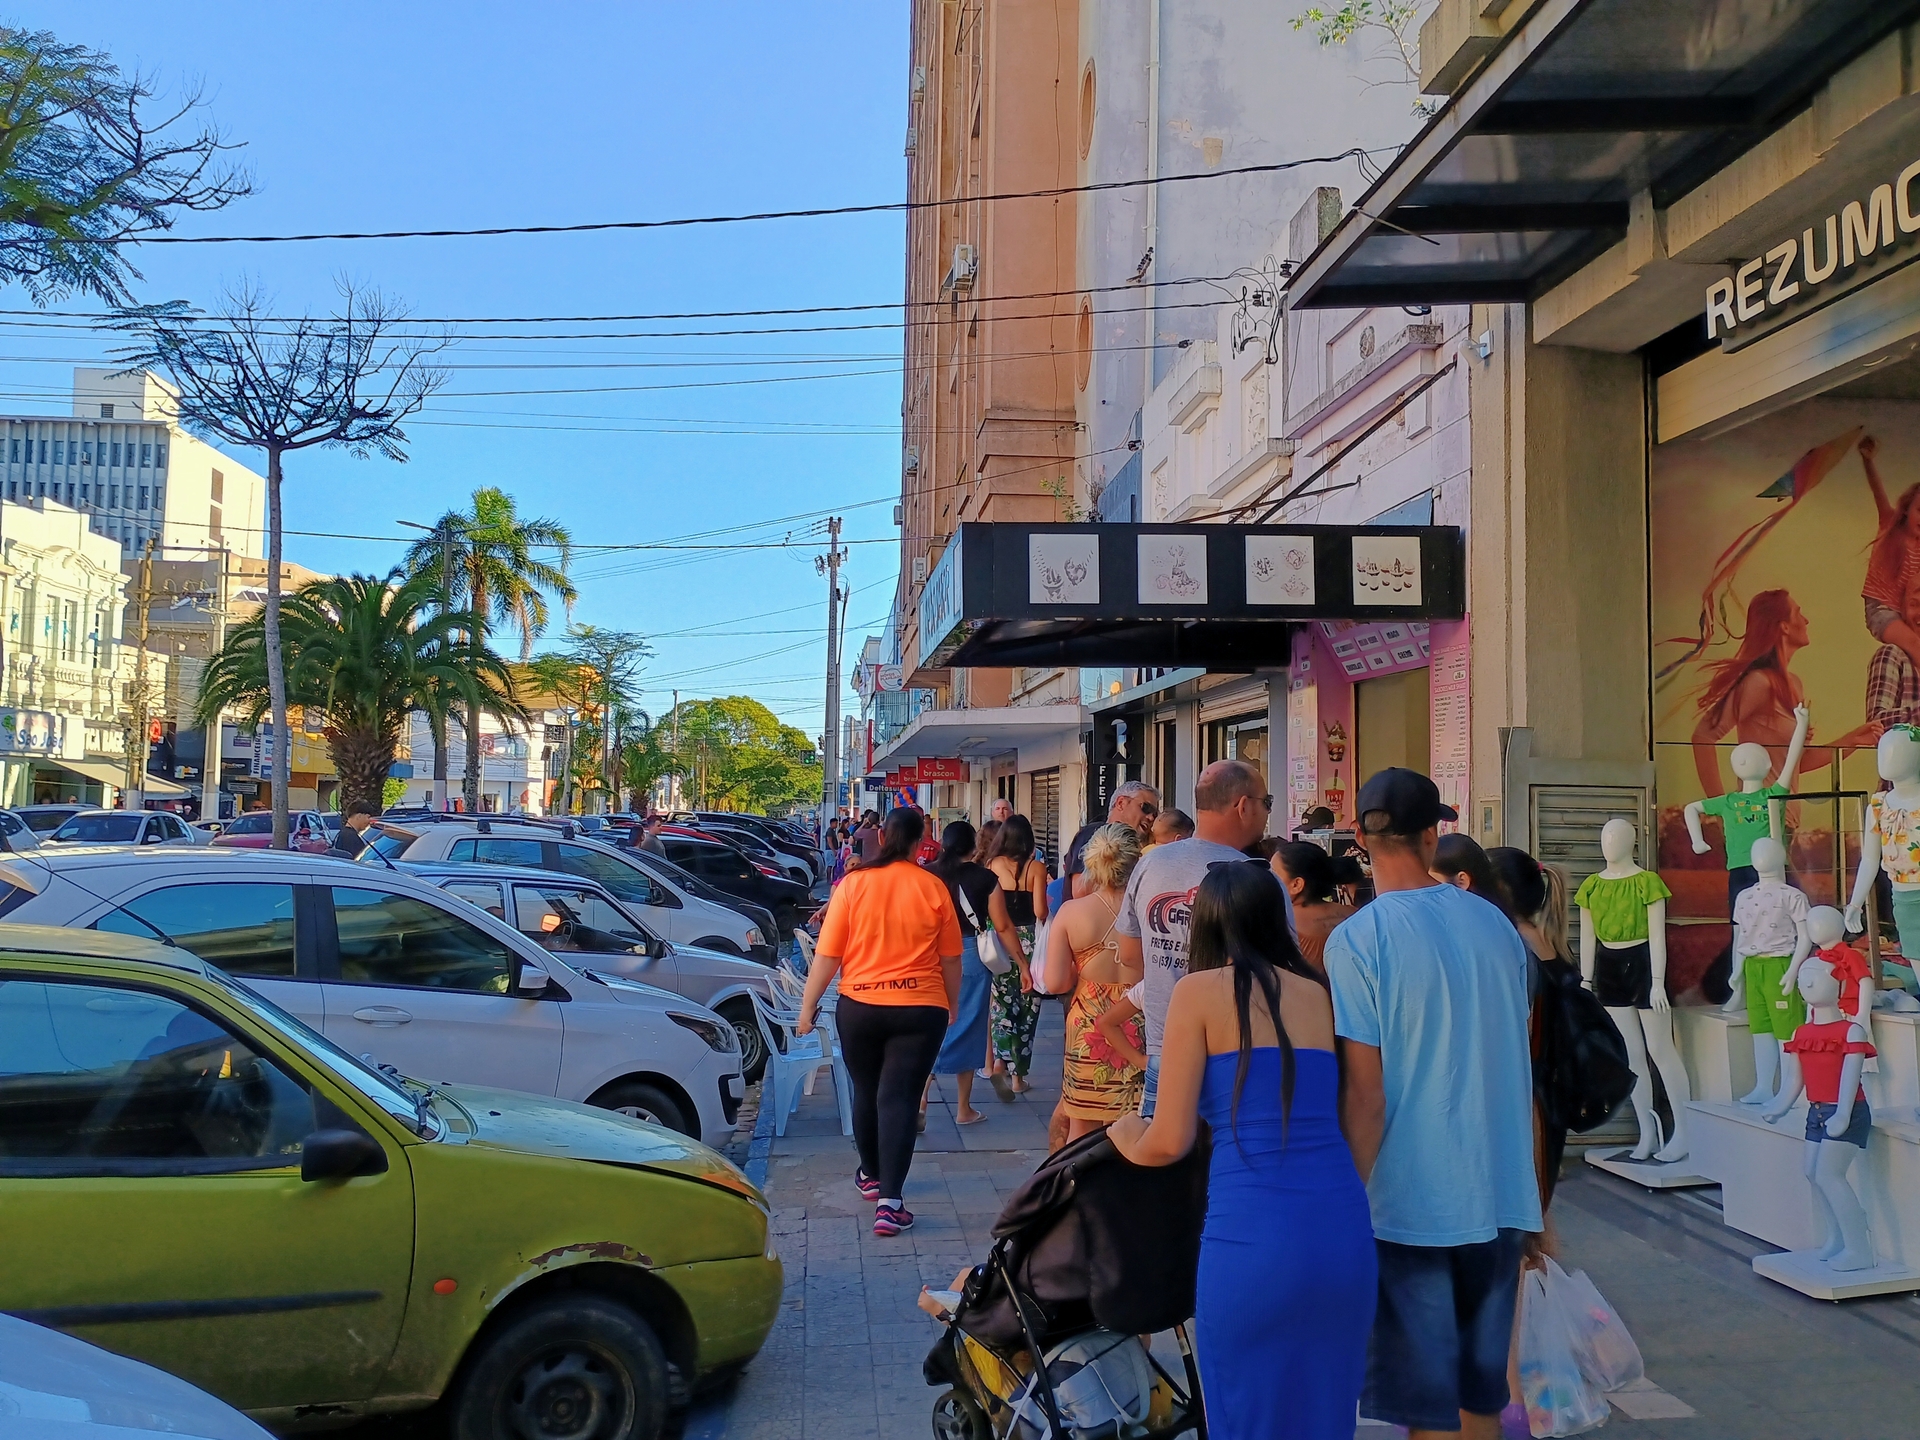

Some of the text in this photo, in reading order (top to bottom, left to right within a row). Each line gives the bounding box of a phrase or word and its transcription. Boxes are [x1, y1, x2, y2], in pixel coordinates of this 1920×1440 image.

[1151, 937, 1174, 951] FRETES
[1174, 941, 1181, 952] E
[1158, 955, 1173, 970] (53)
